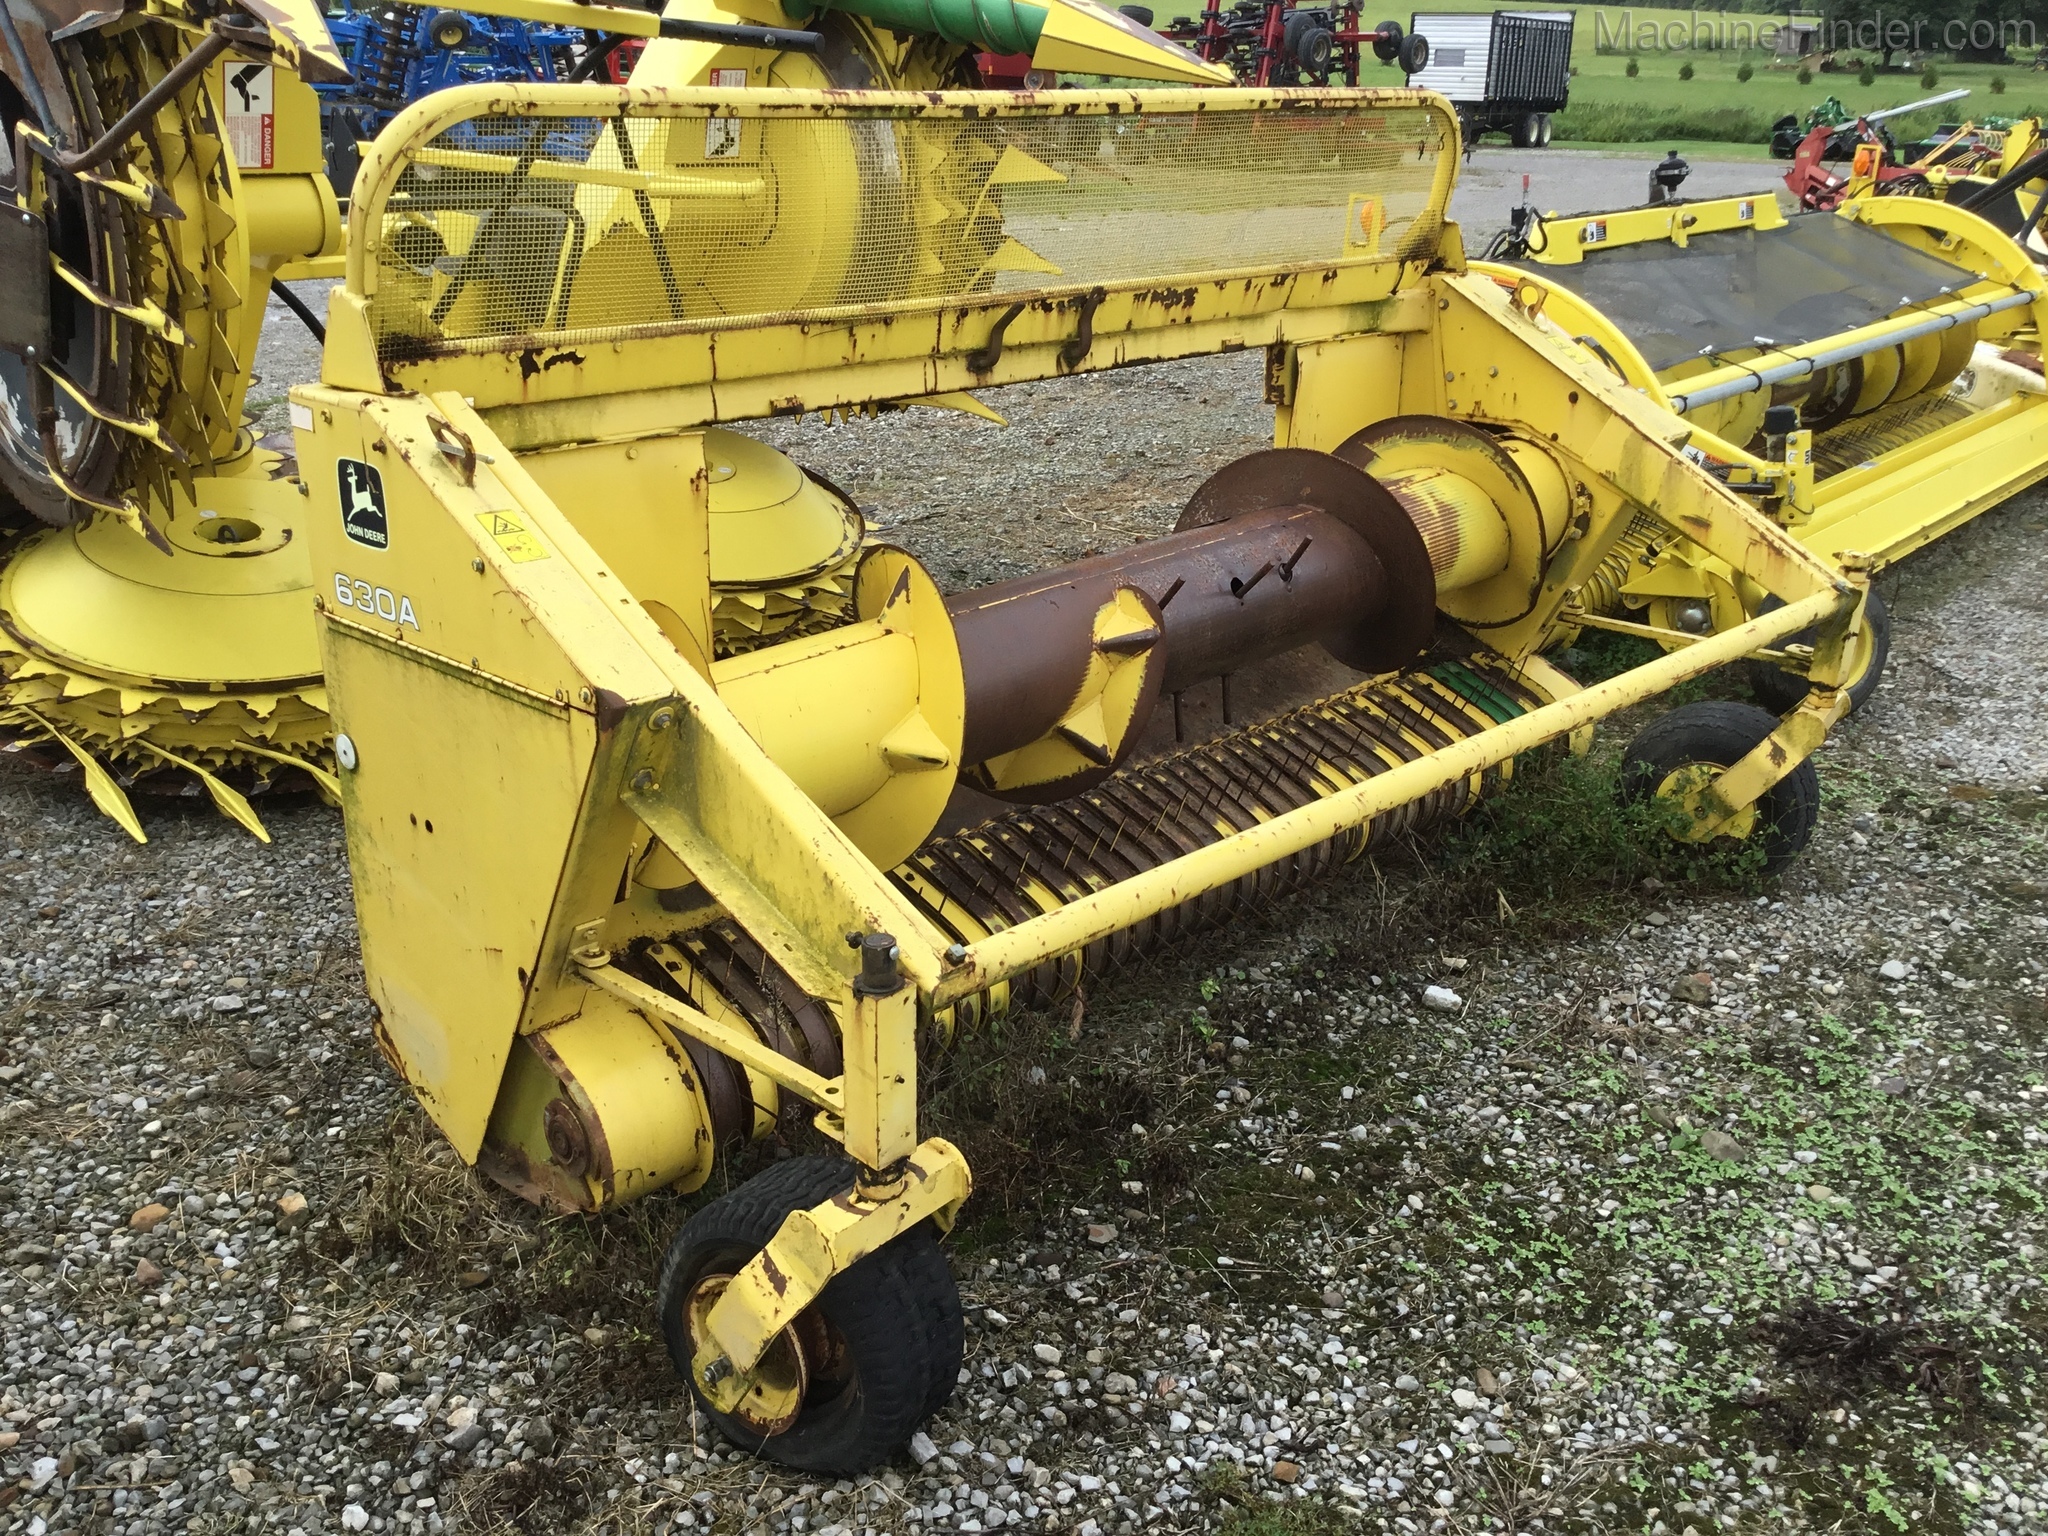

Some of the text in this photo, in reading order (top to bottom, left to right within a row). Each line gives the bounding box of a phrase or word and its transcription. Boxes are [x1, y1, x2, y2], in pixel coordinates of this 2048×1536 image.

[264, 127, 272, 165] DANGER
[346, 523, 386, 544] JOHN DEERE
[334, 572, 421, 632] 630A
